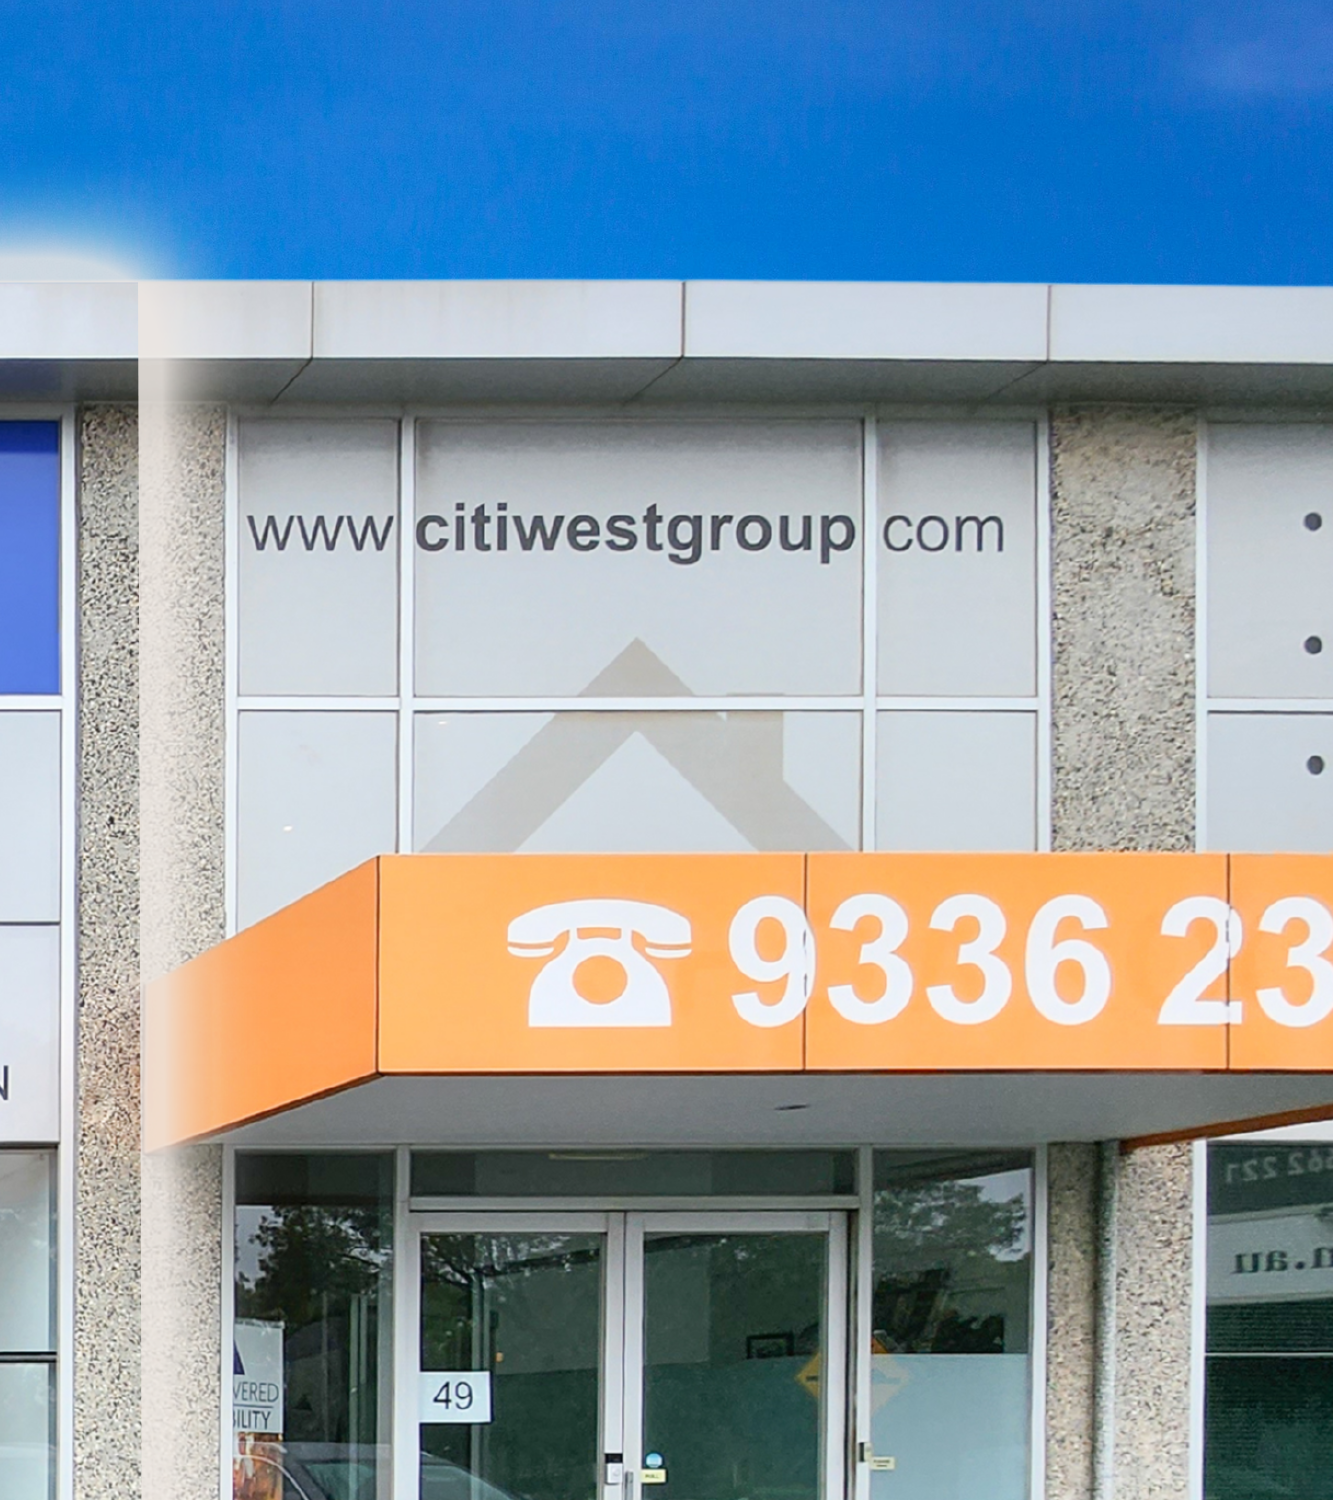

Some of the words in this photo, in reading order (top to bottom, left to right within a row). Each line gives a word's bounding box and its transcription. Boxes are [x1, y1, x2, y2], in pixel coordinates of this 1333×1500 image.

[246, 512, 395, 552] www
[415, 503, 857, 564] citiwestgroup
[882, 512, 1005, 552] com
[729, 893, 1113, 1027] 9336
[1157, 896, 1333, 1027] 23
[433, 1381, 473, 1410] 49
